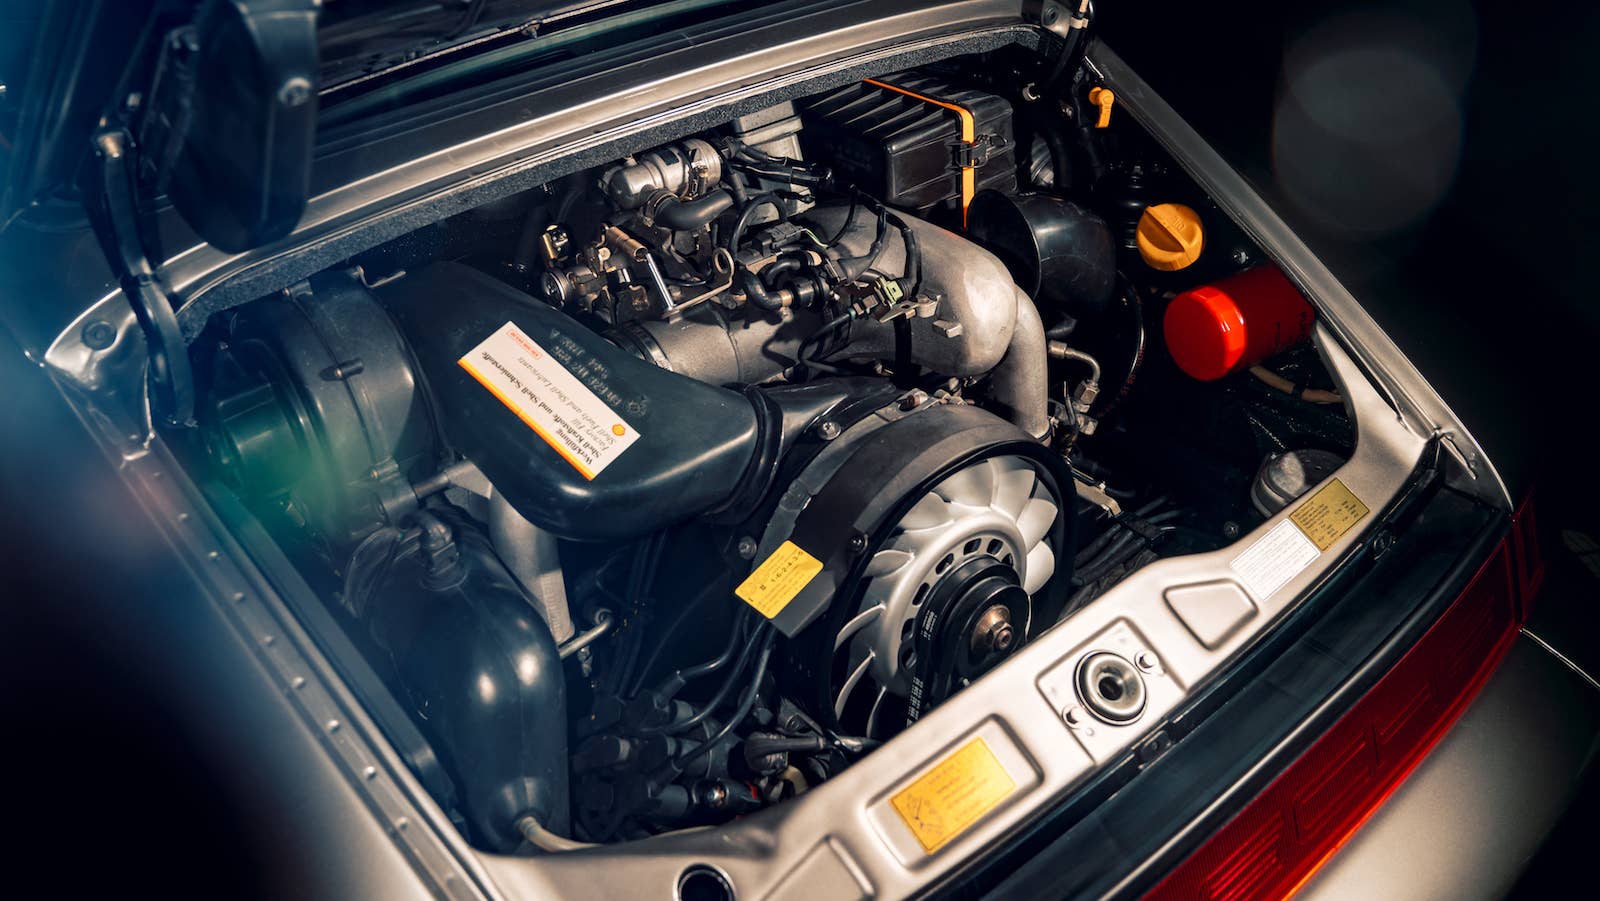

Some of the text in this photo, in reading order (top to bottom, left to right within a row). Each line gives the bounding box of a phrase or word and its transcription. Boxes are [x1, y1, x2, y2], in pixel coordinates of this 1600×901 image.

[482, 352, 601, 458] Shell Kraftstoffe und Shell Schmierstoffe
[517, 357, 616, 446] Shell Fuels and Shell Lubricants
[555, 428, 593, 465] Werkfüllung
[570, 418, 609, 451] Factory Fill
